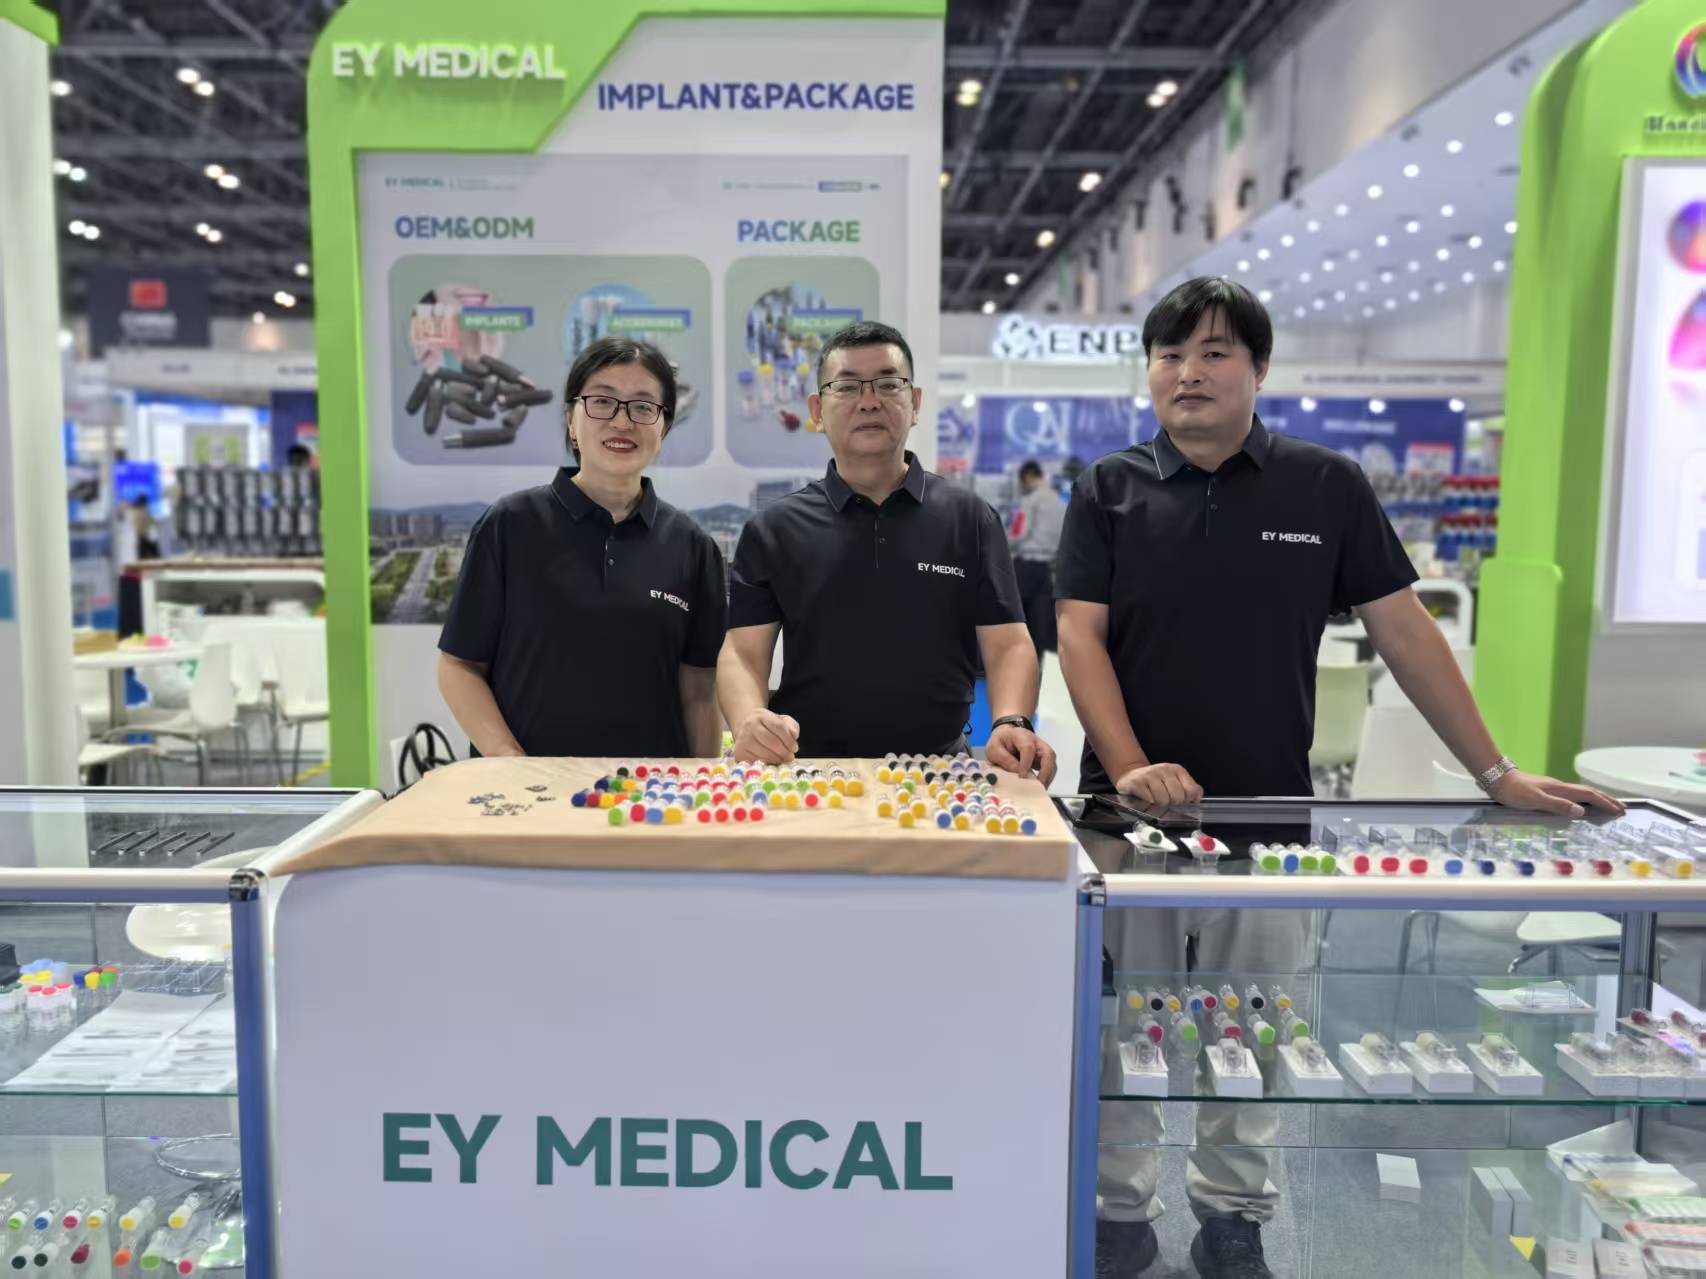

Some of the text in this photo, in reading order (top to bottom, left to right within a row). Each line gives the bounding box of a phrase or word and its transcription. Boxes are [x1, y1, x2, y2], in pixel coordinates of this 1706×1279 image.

[331, 43, 567, 79] EY MEDICAL
[597, 81, 916, 112] IMPLANT&PACKAGE
[395, 215, 535, 240] OEM&ODM
[737, 219, 861, 243] PACKAGE
[1261, 531, 1323, 545] EY MEDICAL
[917, 562, 930, 571] EY
[649, 589, 662, 599] EY
[382, 1112, 954, 1191] EY MEDICAL
